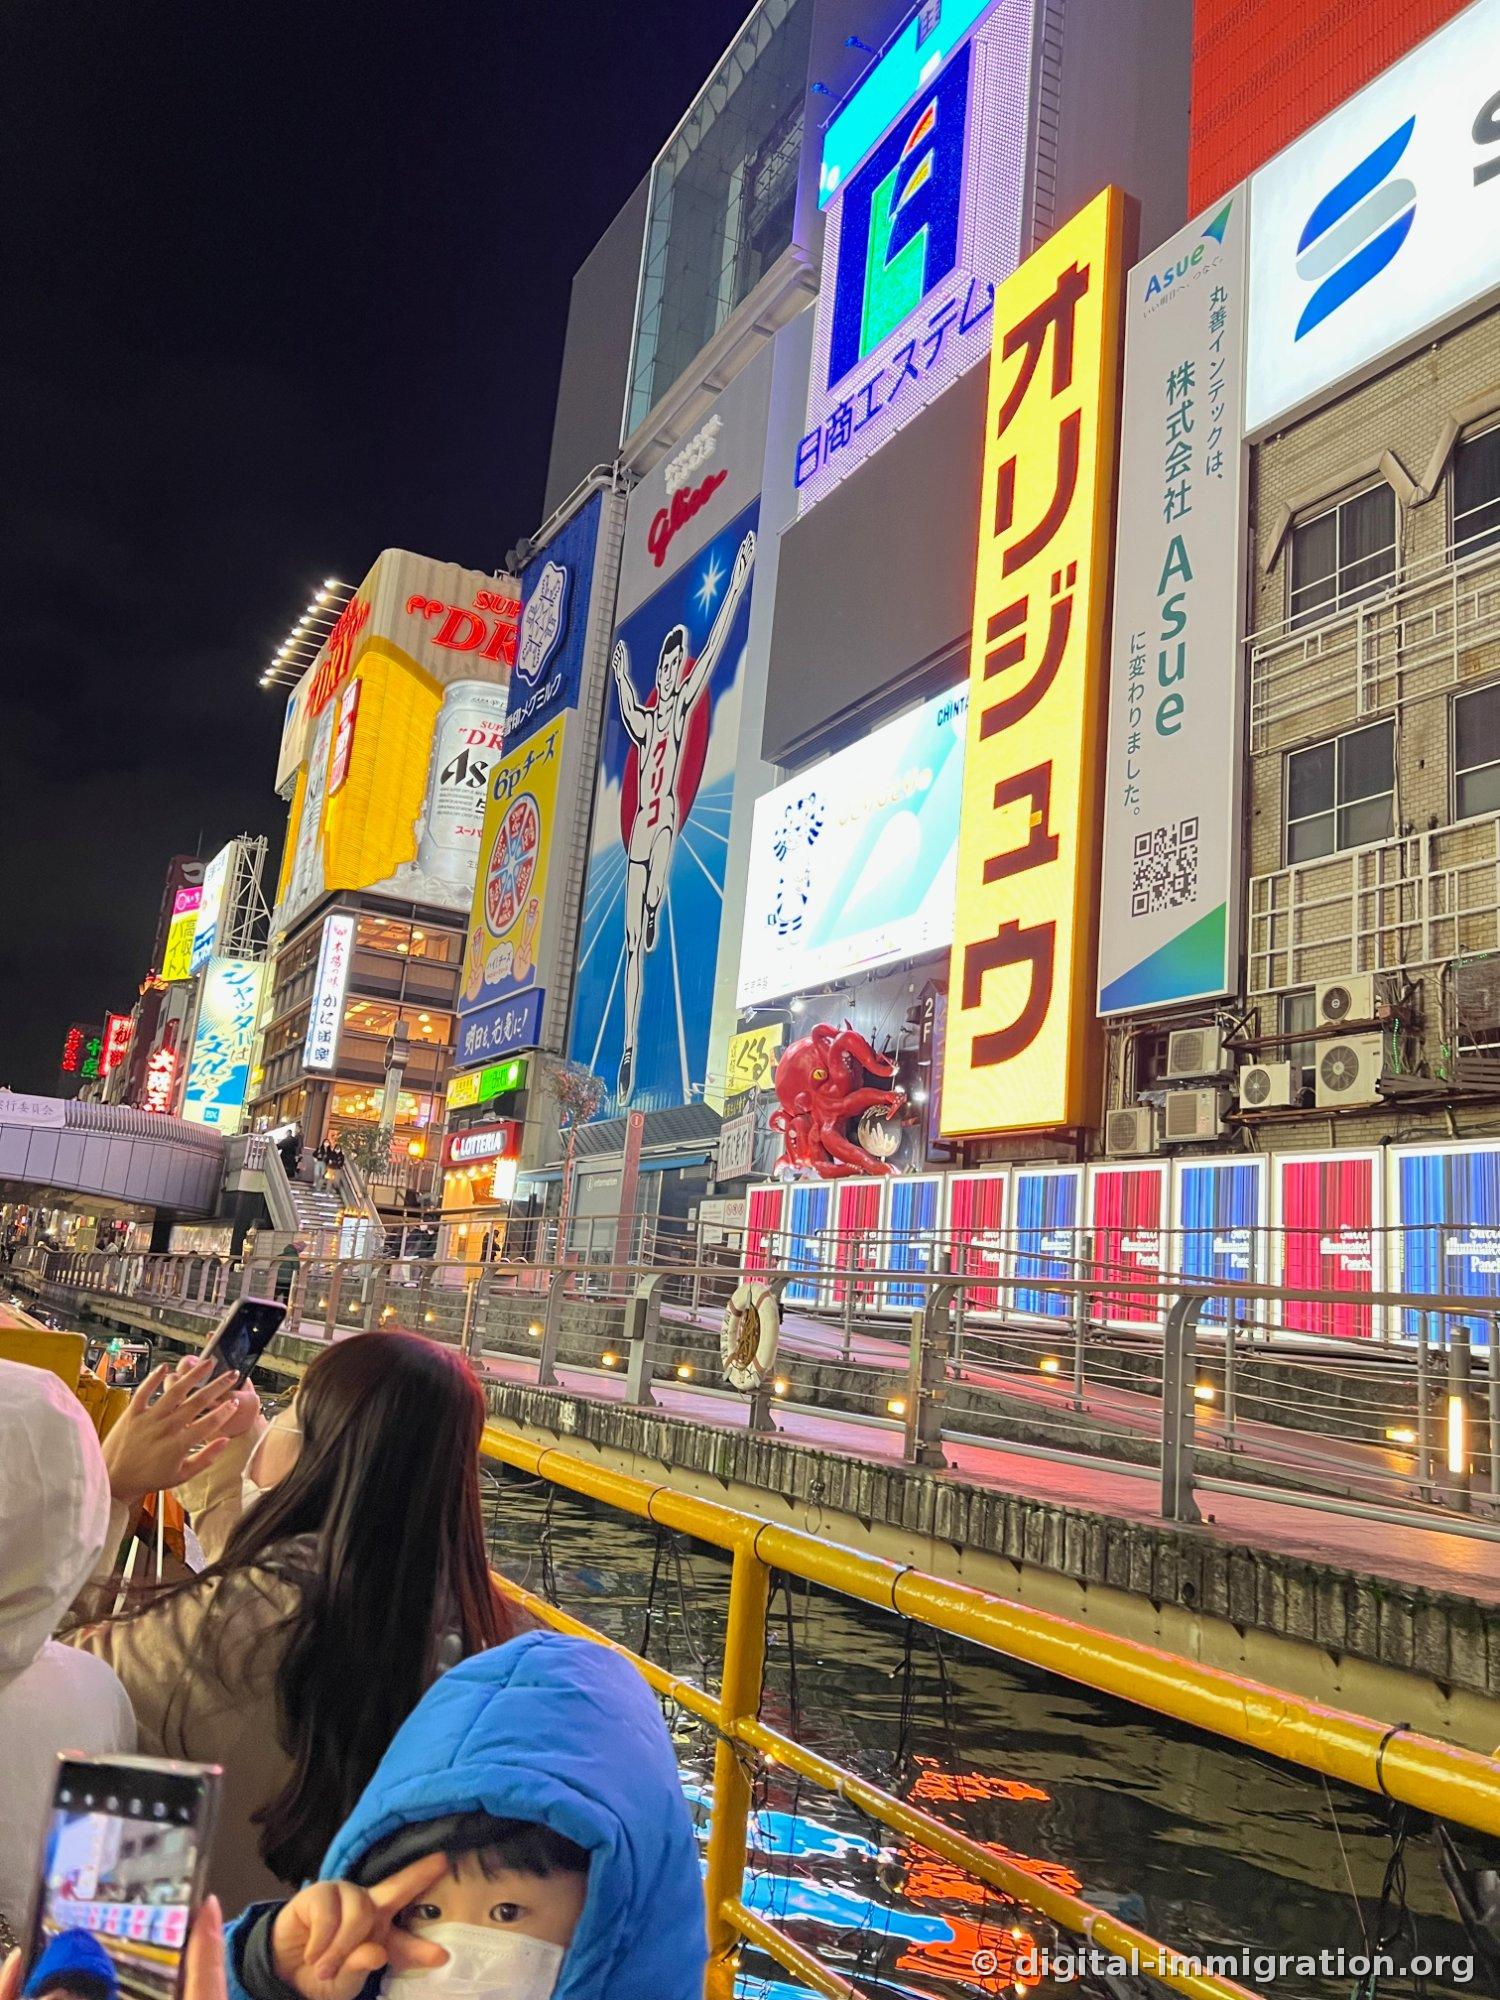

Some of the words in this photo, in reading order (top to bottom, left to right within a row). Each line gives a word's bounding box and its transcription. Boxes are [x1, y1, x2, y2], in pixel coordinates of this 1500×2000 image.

[1145, 244, 1205, 303] Asue
[795, 277, 995, 489] 日商エステム
[1164, 361, 1195, 524] 株式会社
[1206, 286, 1228, 479] 丸善インテックは、
[1155, 535, 1194, 736] Asue
[502, 673, 562, 738] 雪印メグミルク
[1124, 632, 1147, 817] に変わりました。
[647, 731, 669, 828] グリコ
[924, 997, 934, 1043] 2F
[461, 1131, 502, 1157] LOTTERIA
